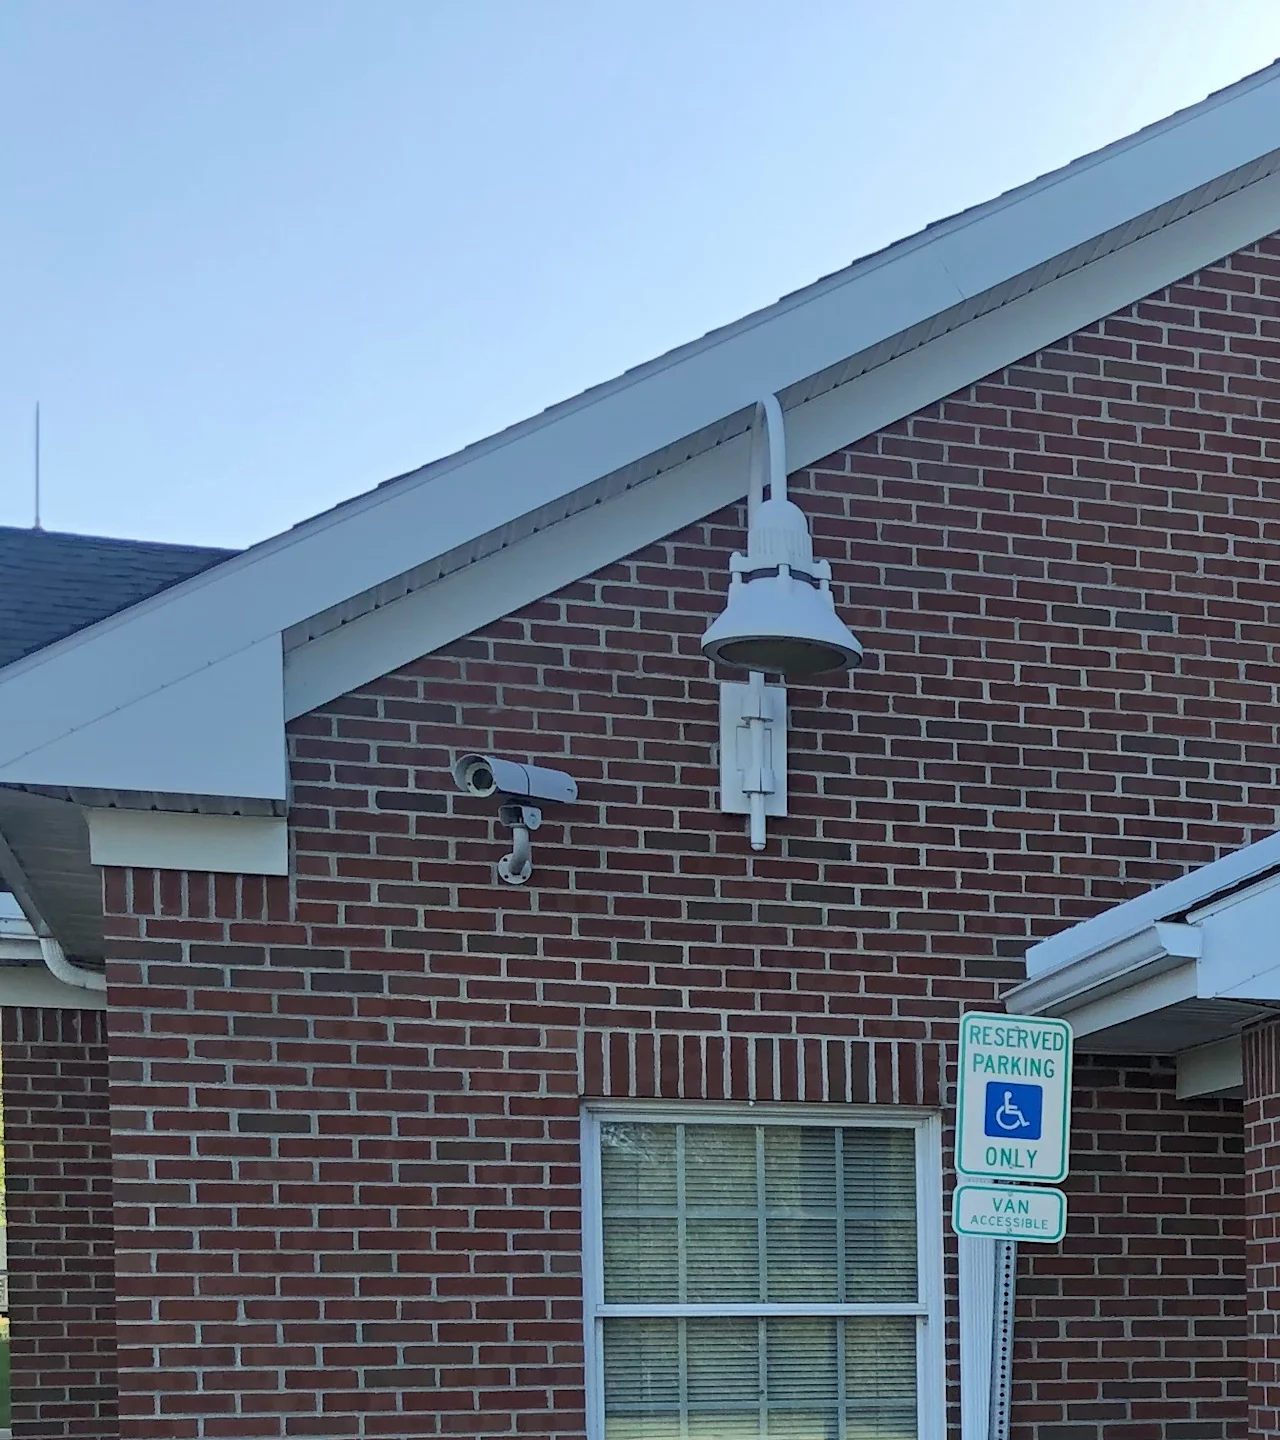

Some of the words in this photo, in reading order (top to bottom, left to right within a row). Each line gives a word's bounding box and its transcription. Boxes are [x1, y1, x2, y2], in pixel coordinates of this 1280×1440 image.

[969, 1025, 1064, 1051] RESERVED
[973, 1053, 1055, 1078] PARKING
[985, 1147, 1037, 1169] ONLY
[992, 1197, 1030, 1214] VAN
[970, 1215, 1048, 1230] ACCESSIBLE
